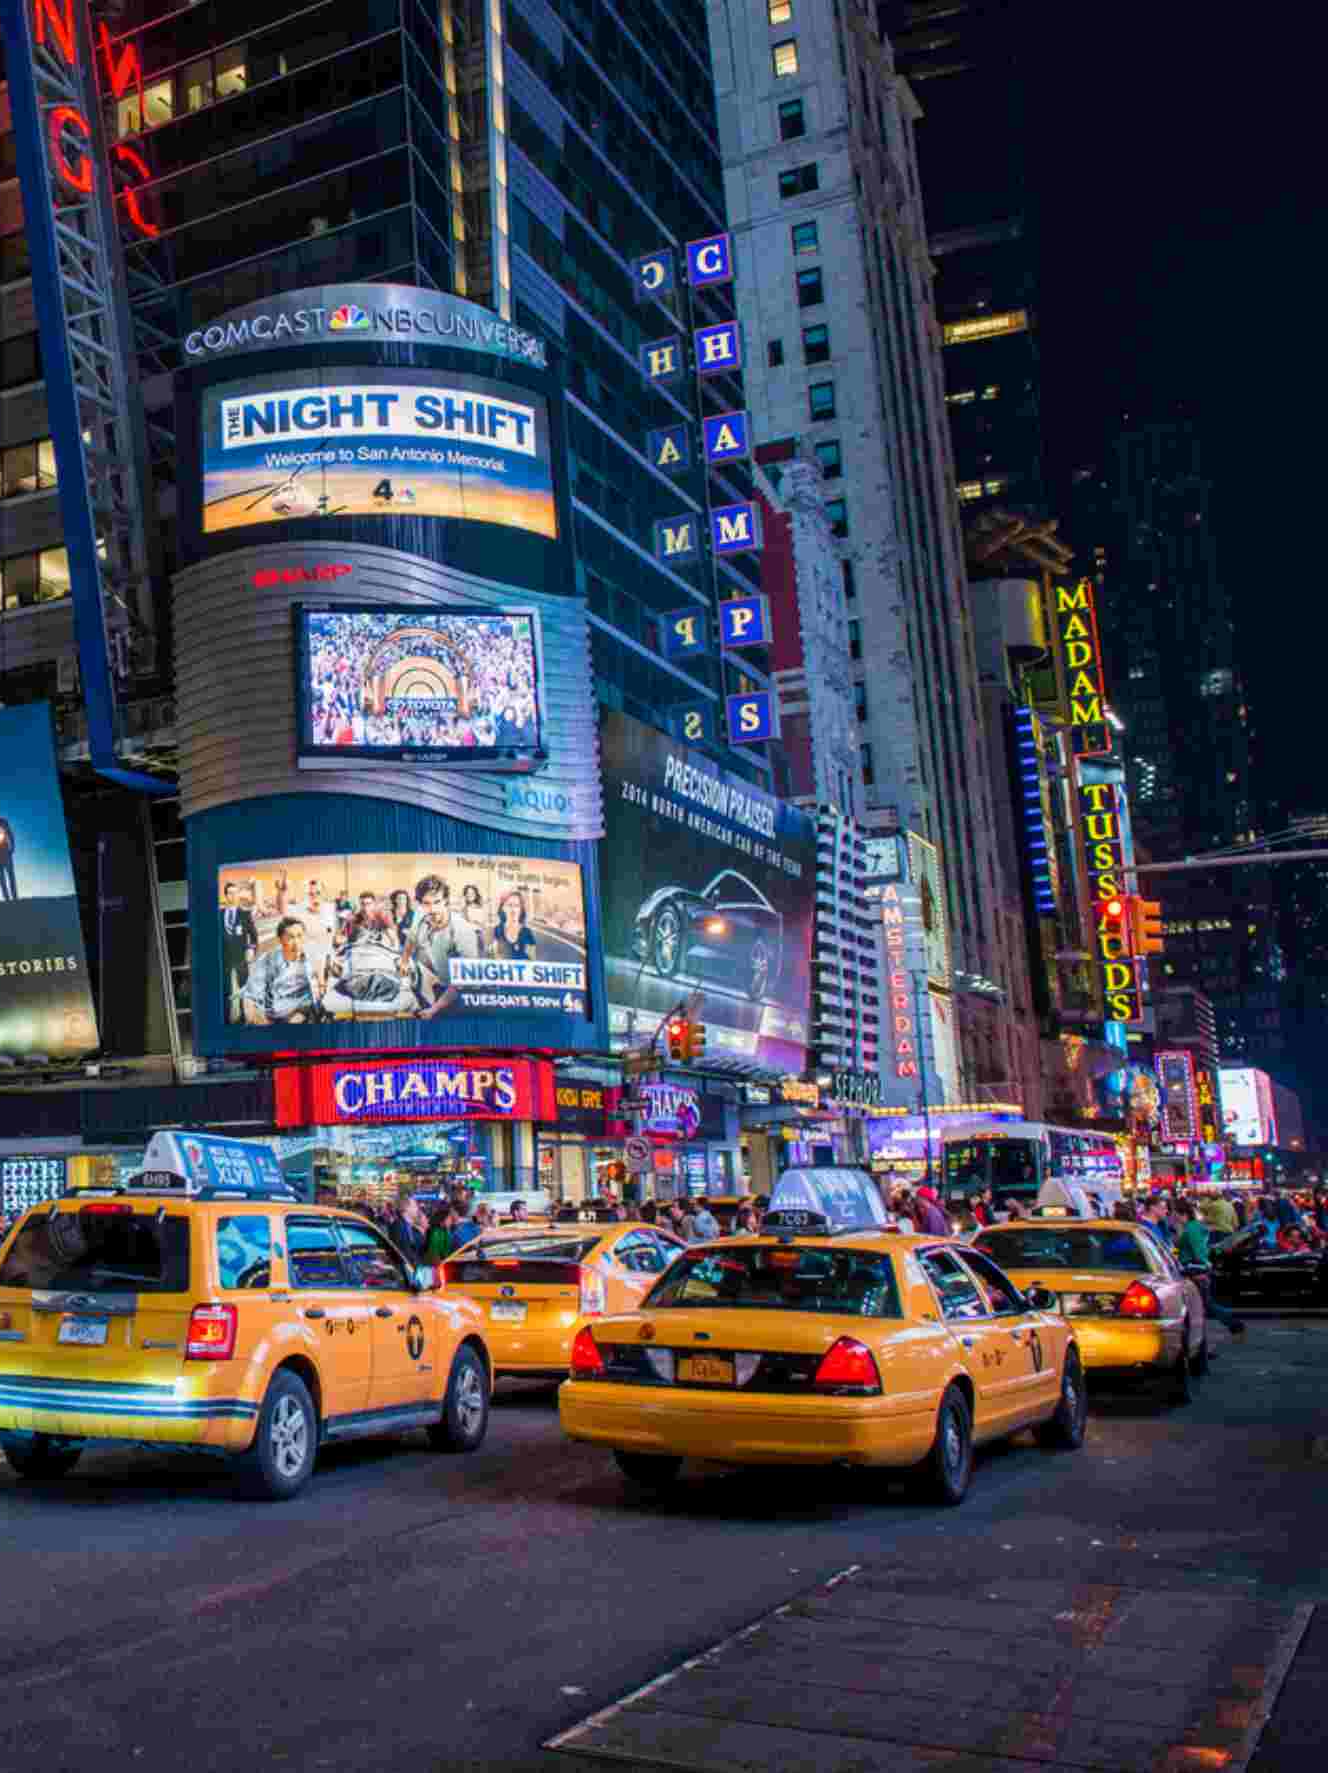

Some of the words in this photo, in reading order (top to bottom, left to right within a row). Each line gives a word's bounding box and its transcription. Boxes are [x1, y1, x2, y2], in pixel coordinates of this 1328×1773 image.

[184, 308, 326, 354] COMCAST
[242, 392, 400, 438] NIGHT
[414, 395, 531, 447] SHIFT
[265, 447, 336, 470] Welcome
[339, 447, 354, 462] to
[357, 446, 388, 461] San
[373, 478, 394, 500] 4
[532, 964, 583, 985] SHIFT
[335, 1070, 517, 1113] CHAMPS
